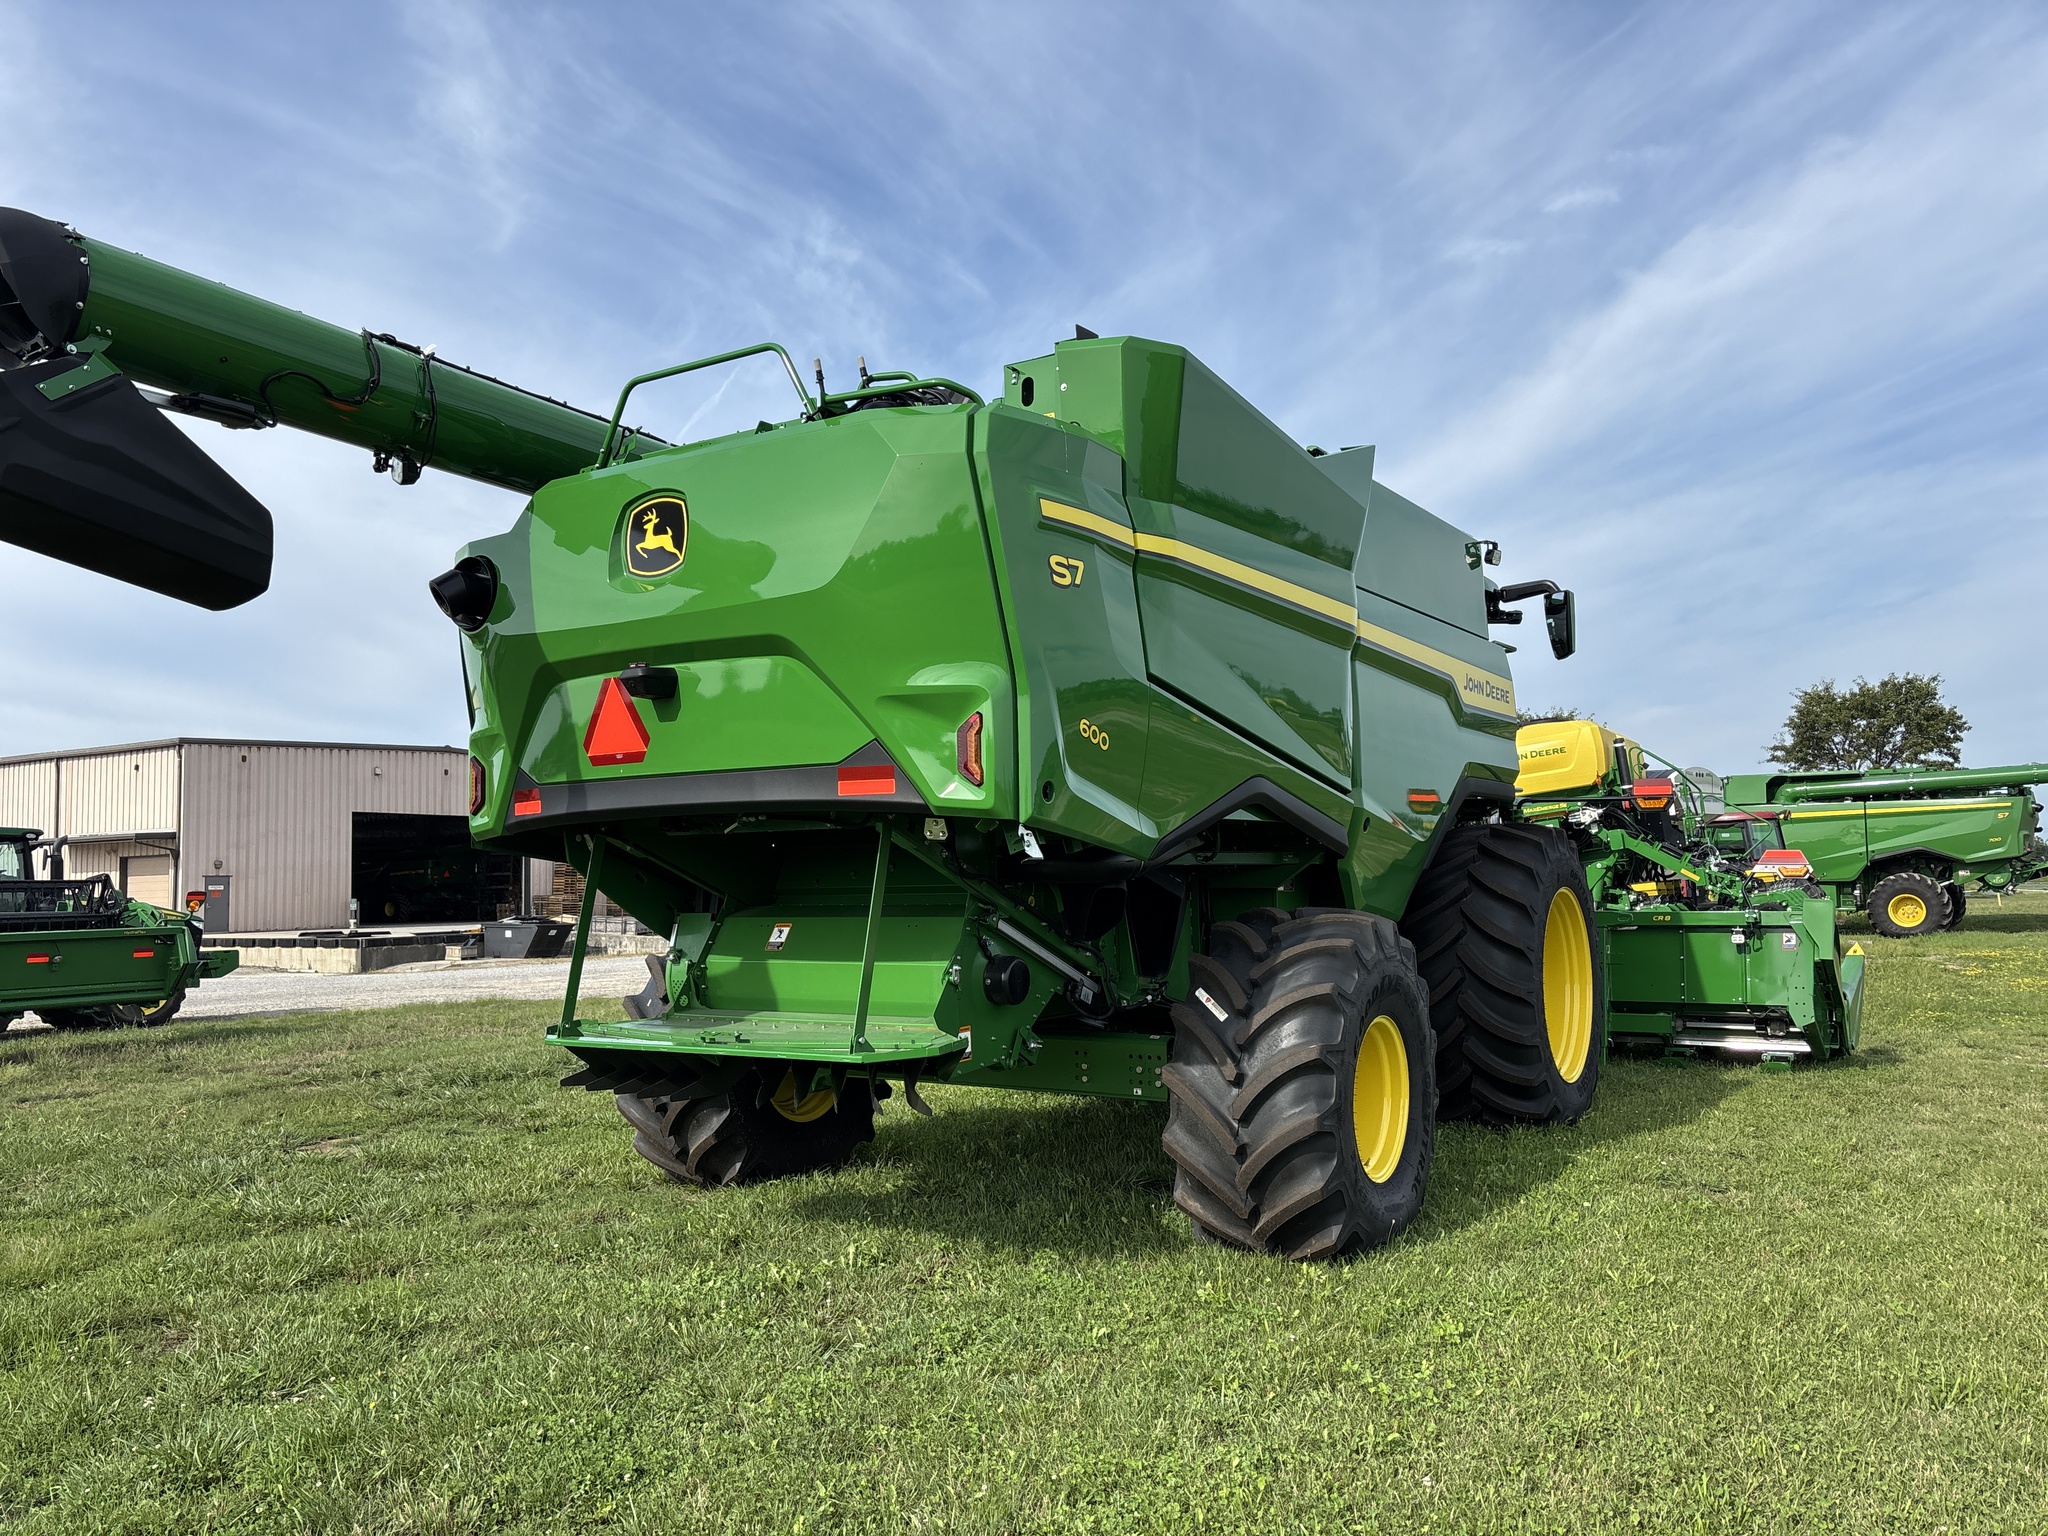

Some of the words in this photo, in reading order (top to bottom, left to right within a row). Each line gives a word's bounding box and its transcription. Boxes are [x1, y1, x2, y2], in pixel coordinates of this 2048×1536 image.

[1048, 554, 1085, 589] S7
[1463, 673, 1485, 696] JOHN
[1485, 680, 1510, 705] DEERE
[1079, 718, 1109, 751] 600
[1530, 746, 1567, 759] DEERE
